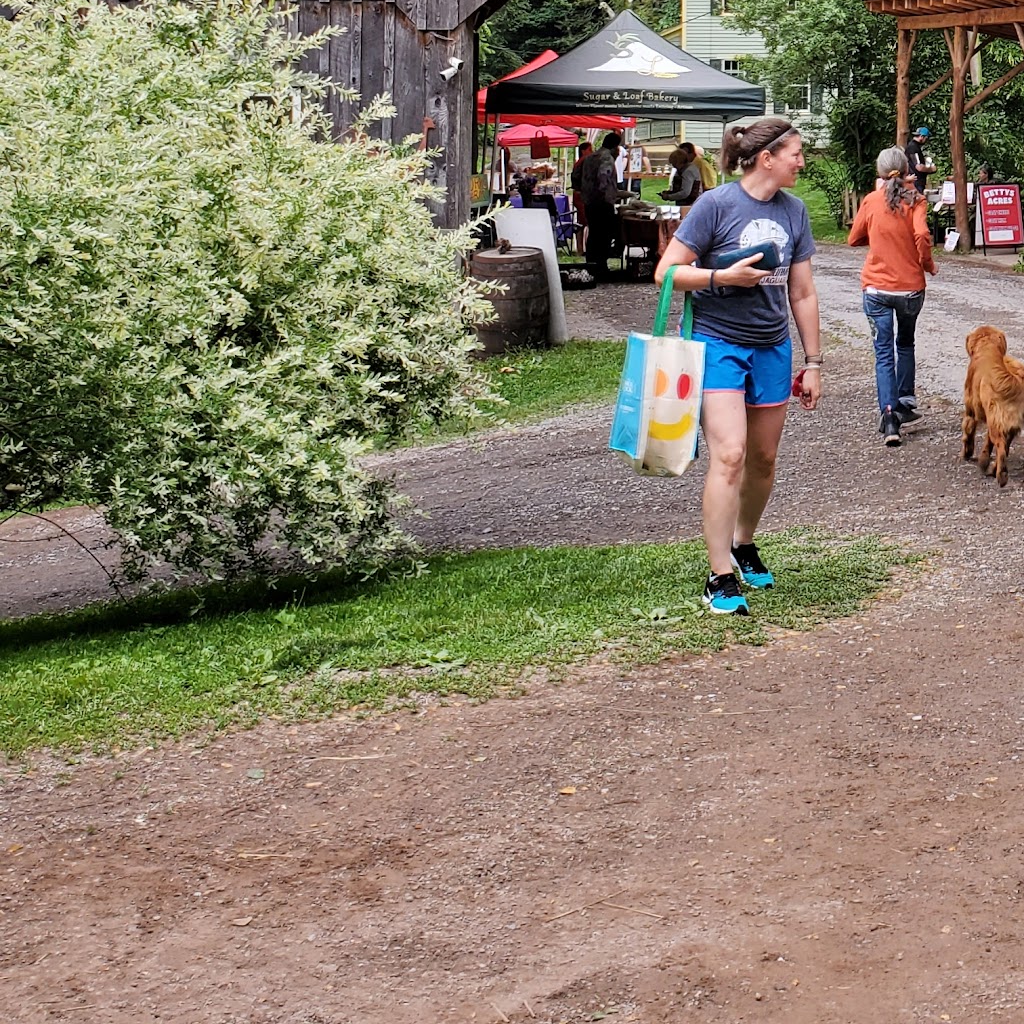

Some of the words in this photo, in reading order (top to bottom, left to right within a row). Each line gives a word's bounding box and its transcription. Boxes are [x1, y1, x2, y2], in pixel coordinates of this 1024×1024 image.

[583, 92, 610, 103] Sugar
[613, 92, 621, 100] &
[623, 90, 645, 103] Loaf
[646, 91, 679, 105] Bakery
[983, 188, 1015, 198] BETTYS
[987, 197, 1013, 205] ACRES
